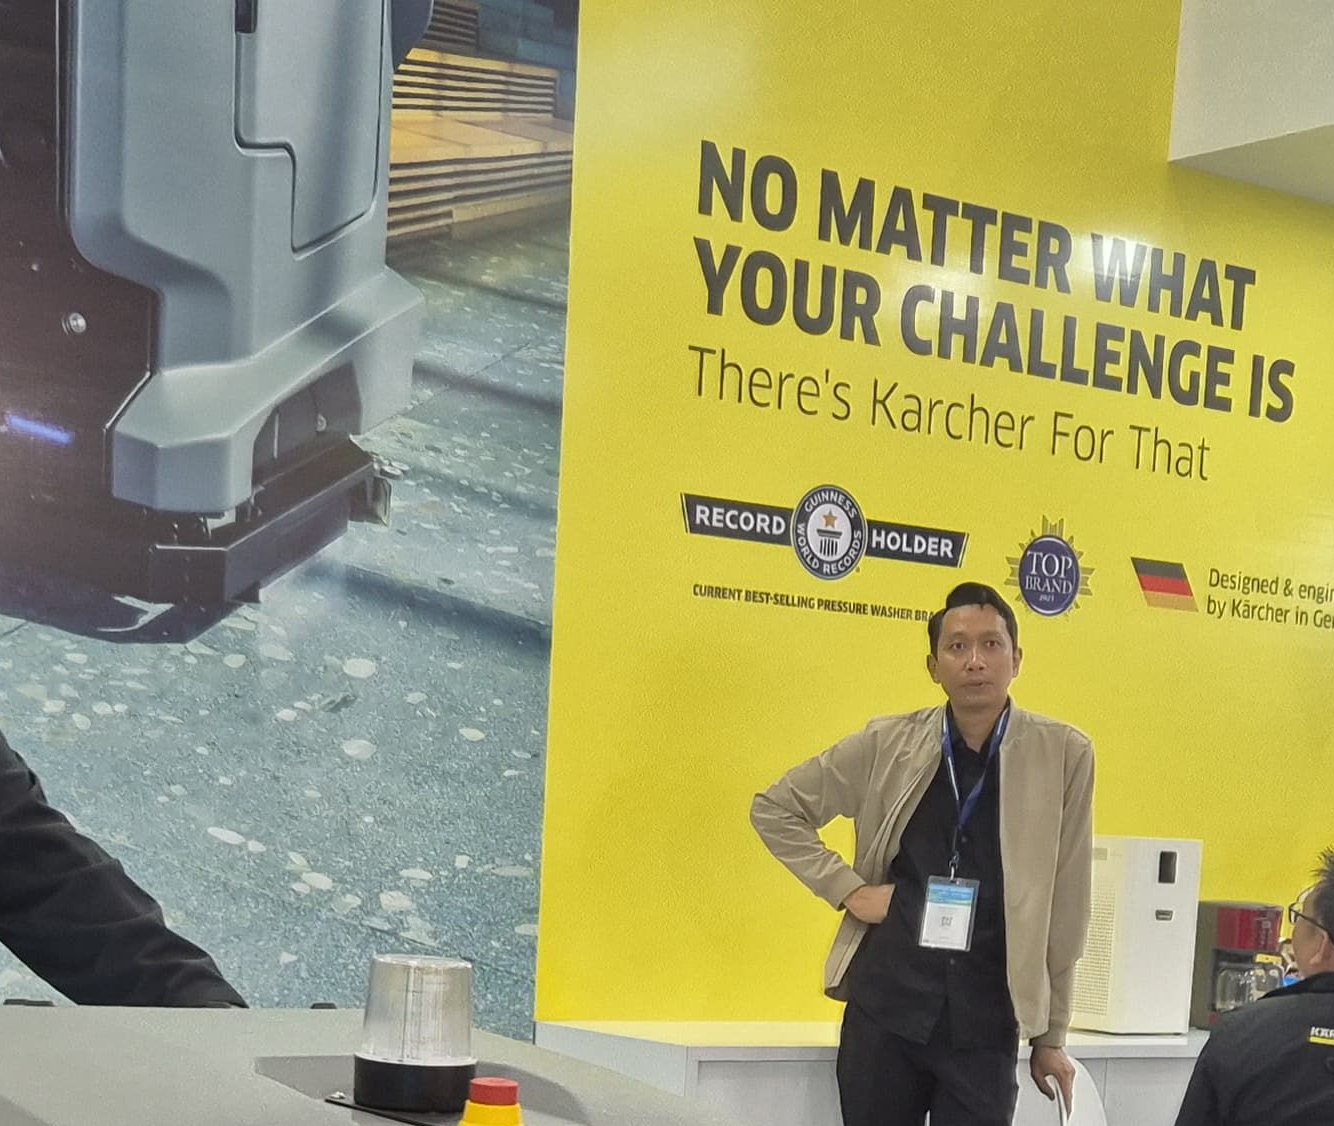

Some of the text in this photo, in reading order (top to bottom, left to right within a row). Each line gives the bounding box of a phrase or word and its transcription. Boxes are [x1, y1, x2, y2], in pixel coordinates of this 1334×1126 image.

[698, 139, 1256, 331] NO MATTER WHAT
[693, 236, 1296, 423] YOUR CHALLENGE IS
[688, 345, 1210, 481] There's Karcher For That
[804, 490, 857, 518] GUINNESS
[695, 504, 953, 558] RECORD HOLDER
[797, 522, 861, 575] WORLD RECORDS
[1027, 550, 1072, 578] TOP
[1025, 575, 1072, 594] BRAND
[1209, 568, 1279, 595] Designed
[1283, 578, 1293, 597] &
[693, 584, 742, 601] CURRENT
[745, 590, 815, 609] BEST-SELLING
[817, 598, 867, 615] PRESSURE
[870, 604, 912, 620] WASHER
[1207, 595, 1226, 619] by
[1231, 598, 1290, 624] Kärcher
[1295, 606, 1308, 626] in
